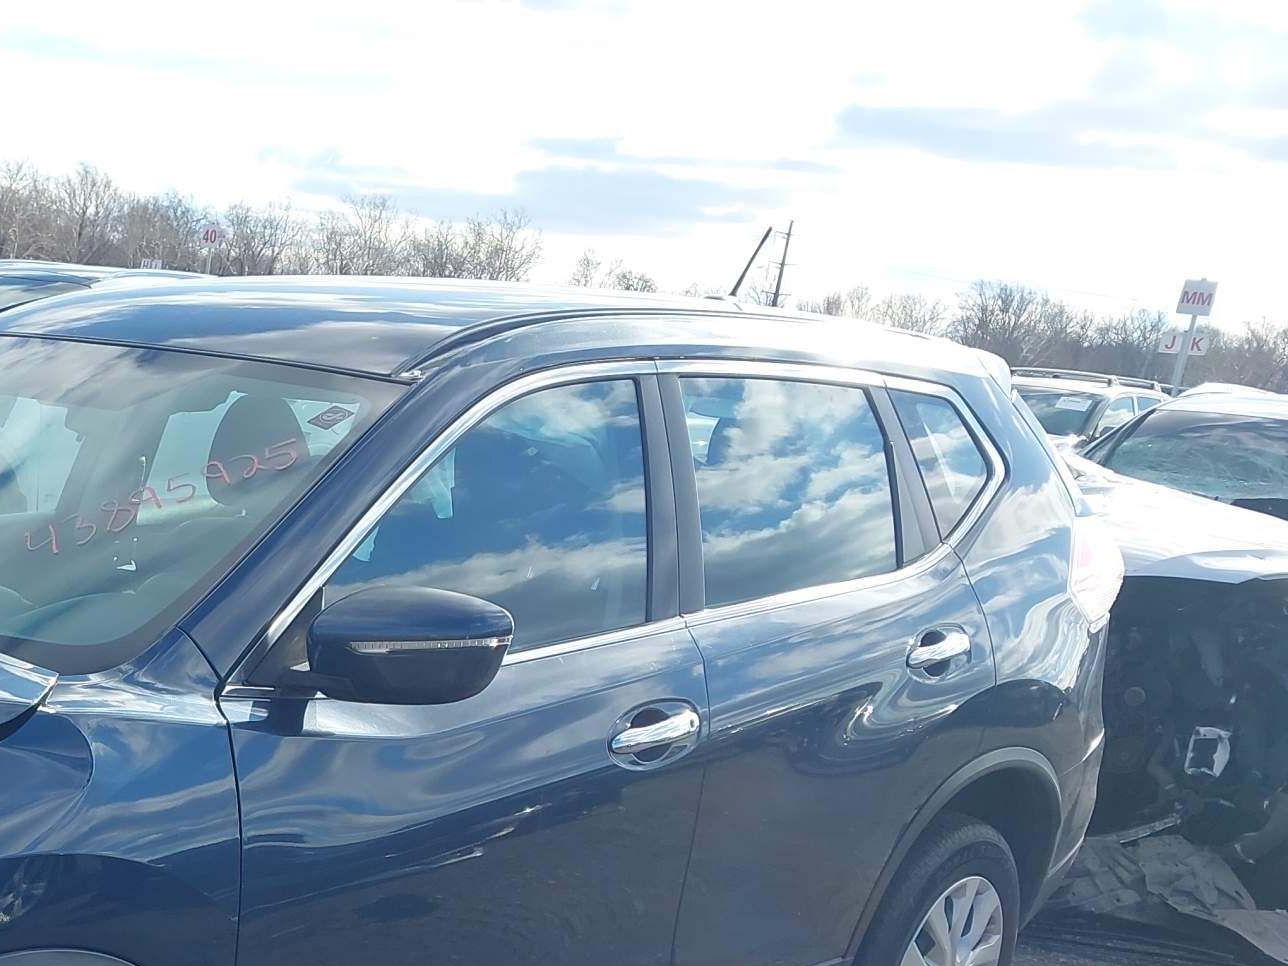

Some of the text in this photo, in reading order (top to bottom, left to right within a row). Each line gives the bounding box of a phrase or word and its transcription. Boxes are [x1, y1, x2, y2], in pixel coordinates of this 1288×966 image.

[203, 230, 217, 243] 40
[1181, 291, 1214, 306] MM
[1165, 336, 1204, 351] J K
[25, 438, 298, 555] 43895925
